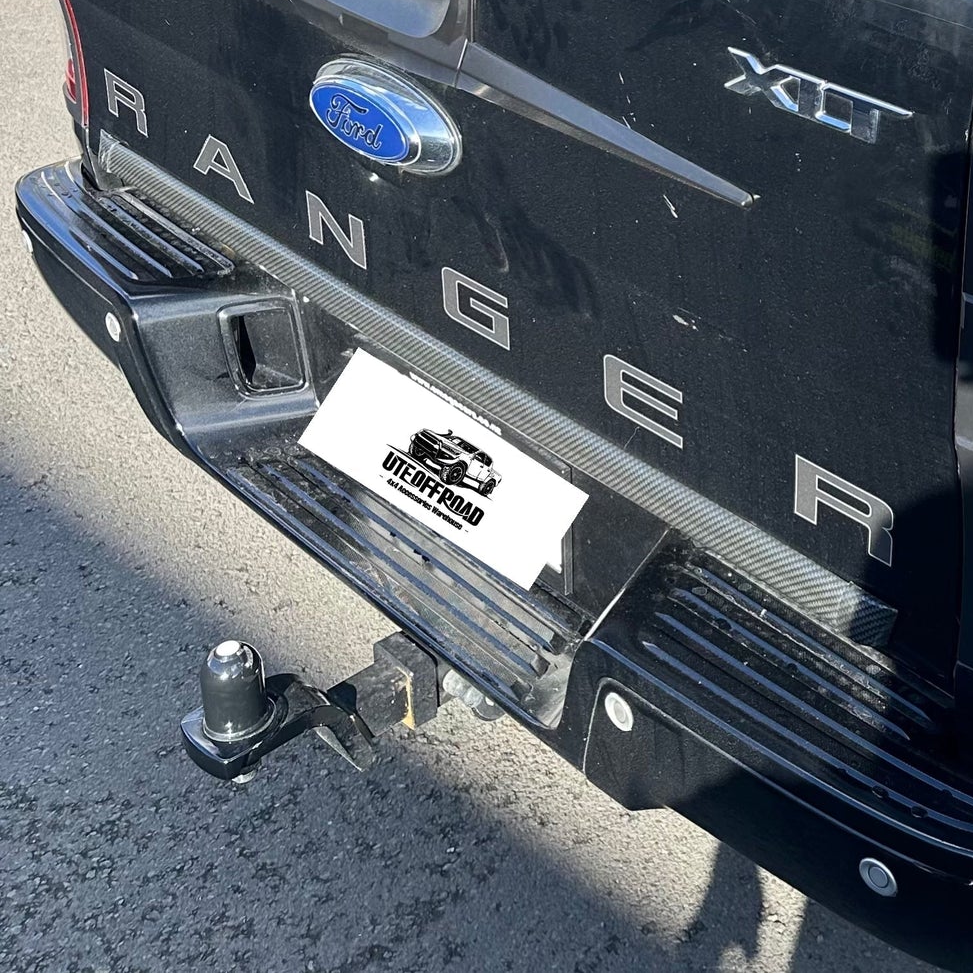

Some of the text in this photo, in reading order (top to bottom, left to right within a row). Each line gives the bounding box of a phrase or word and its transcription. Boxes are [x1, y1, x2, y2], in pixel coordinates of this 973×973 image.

[326, 93, 383, 150] Ford
[724, 46, 914, 144] XLT
[104, 68, 894, 567] RANGER
